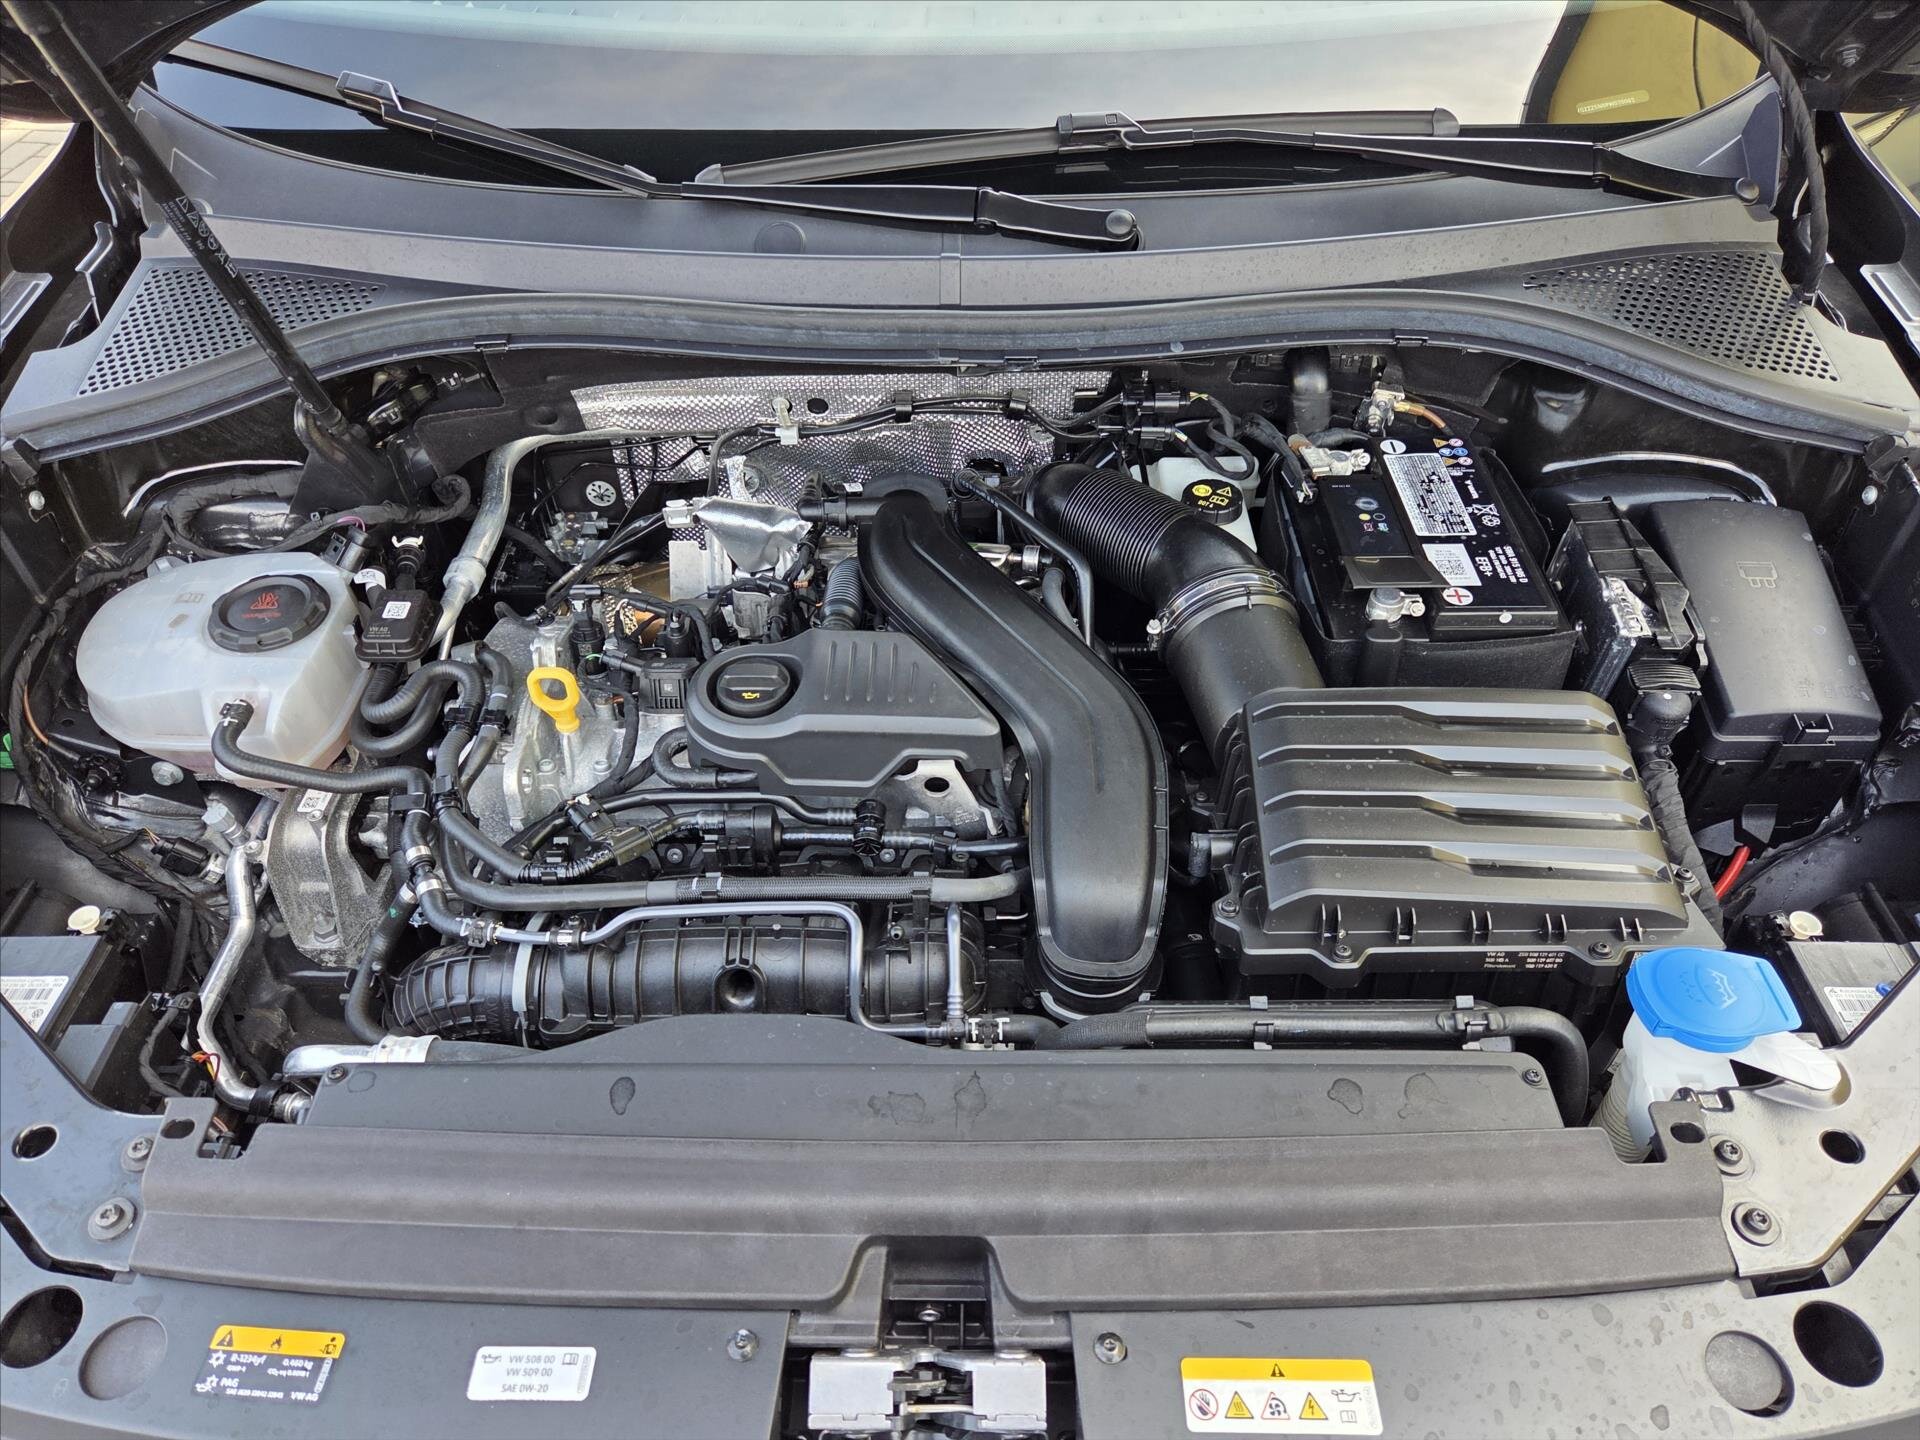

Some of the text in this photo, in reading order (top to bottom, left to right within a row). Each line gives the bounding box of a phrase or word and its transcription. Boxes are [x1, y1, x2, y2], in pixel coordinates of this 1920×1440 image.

[1475, 556, 1493, 577] EFB+
[509, 1355, 556, 1364] VW 508 00
[303, 1360, 314, 1370] kg
[506, 1368, 553, 1377] VW 509 00
[220, 1377, 239, 1387] PAG
[501, 1384, 549, 1393] SAE 0W-20
[290, 1391, 319, 1402] VW AG
